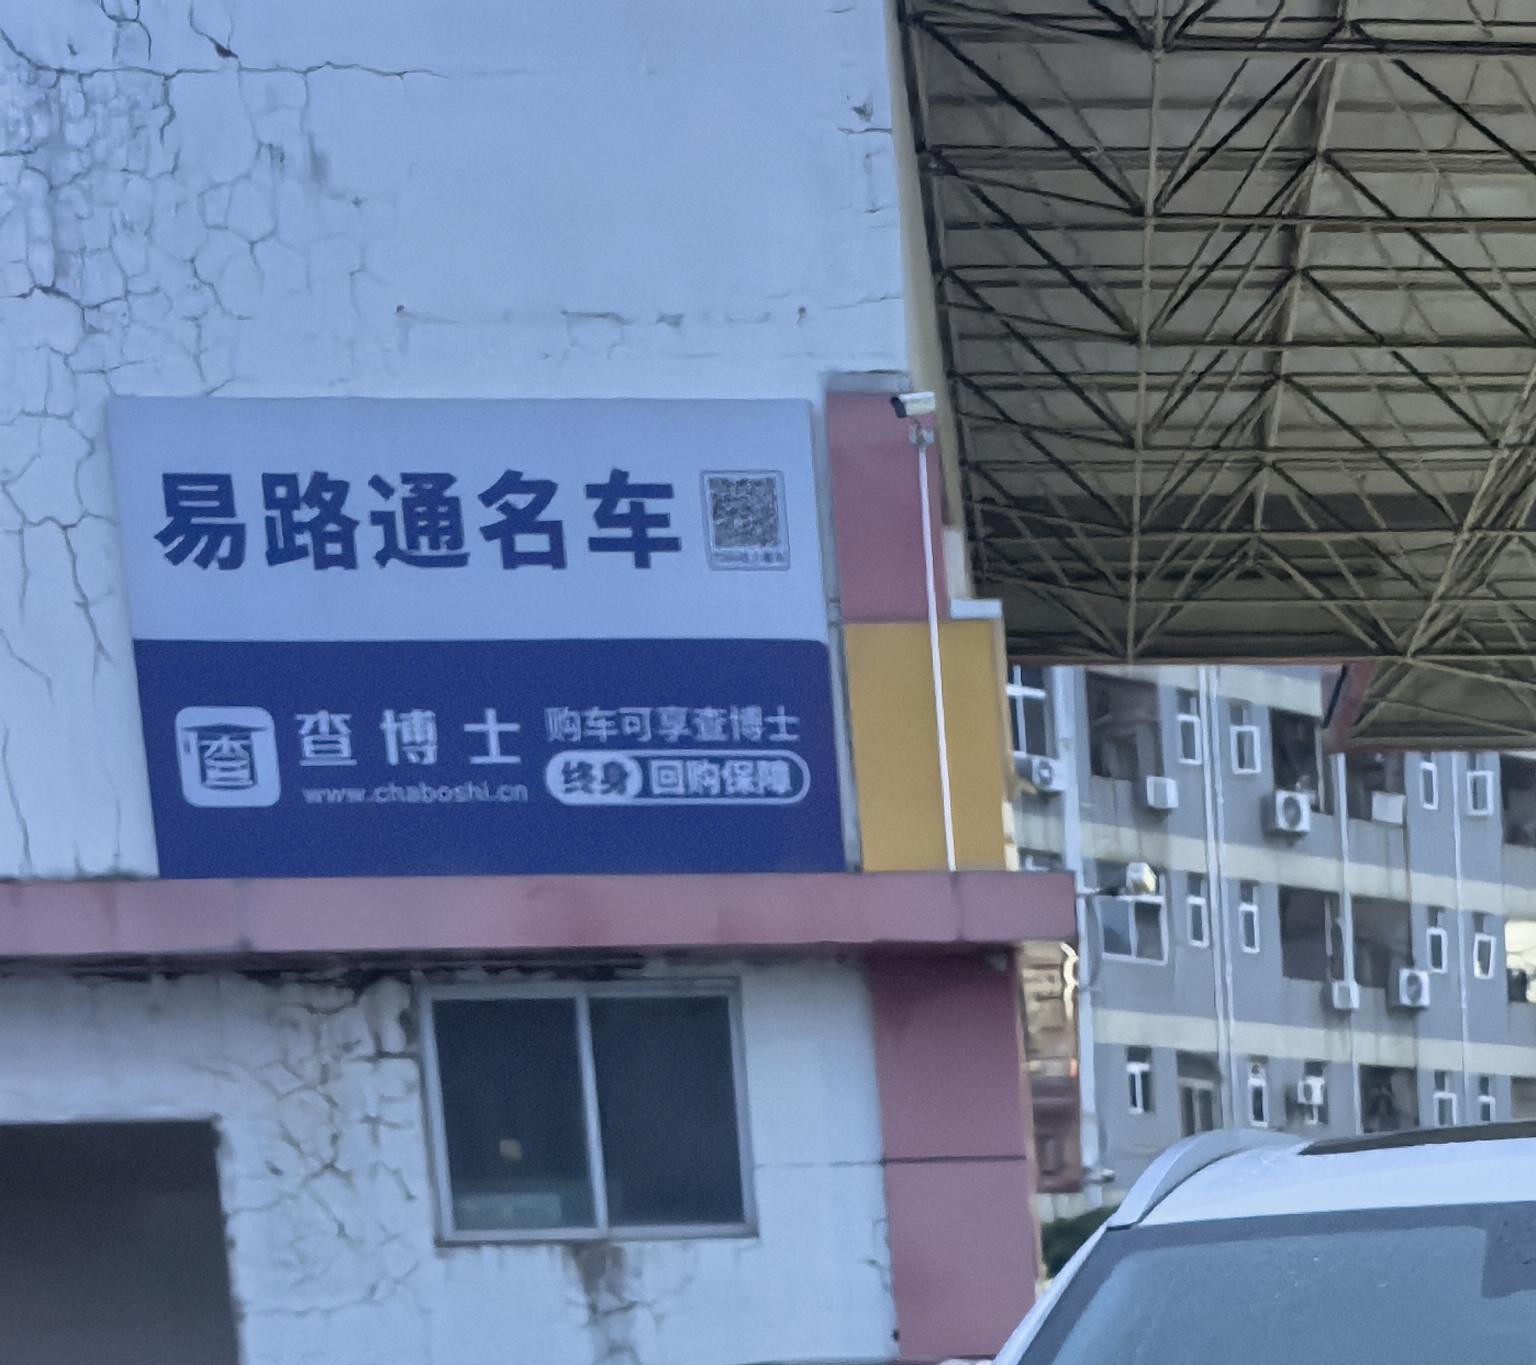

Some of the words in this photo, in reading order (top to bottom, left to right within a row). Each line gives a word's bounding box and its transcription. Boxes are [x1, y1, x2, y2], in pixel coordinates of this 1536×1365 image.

[154, 469, 682, 570] 易路通名车
[294, 707, 522, 767] 查博士
